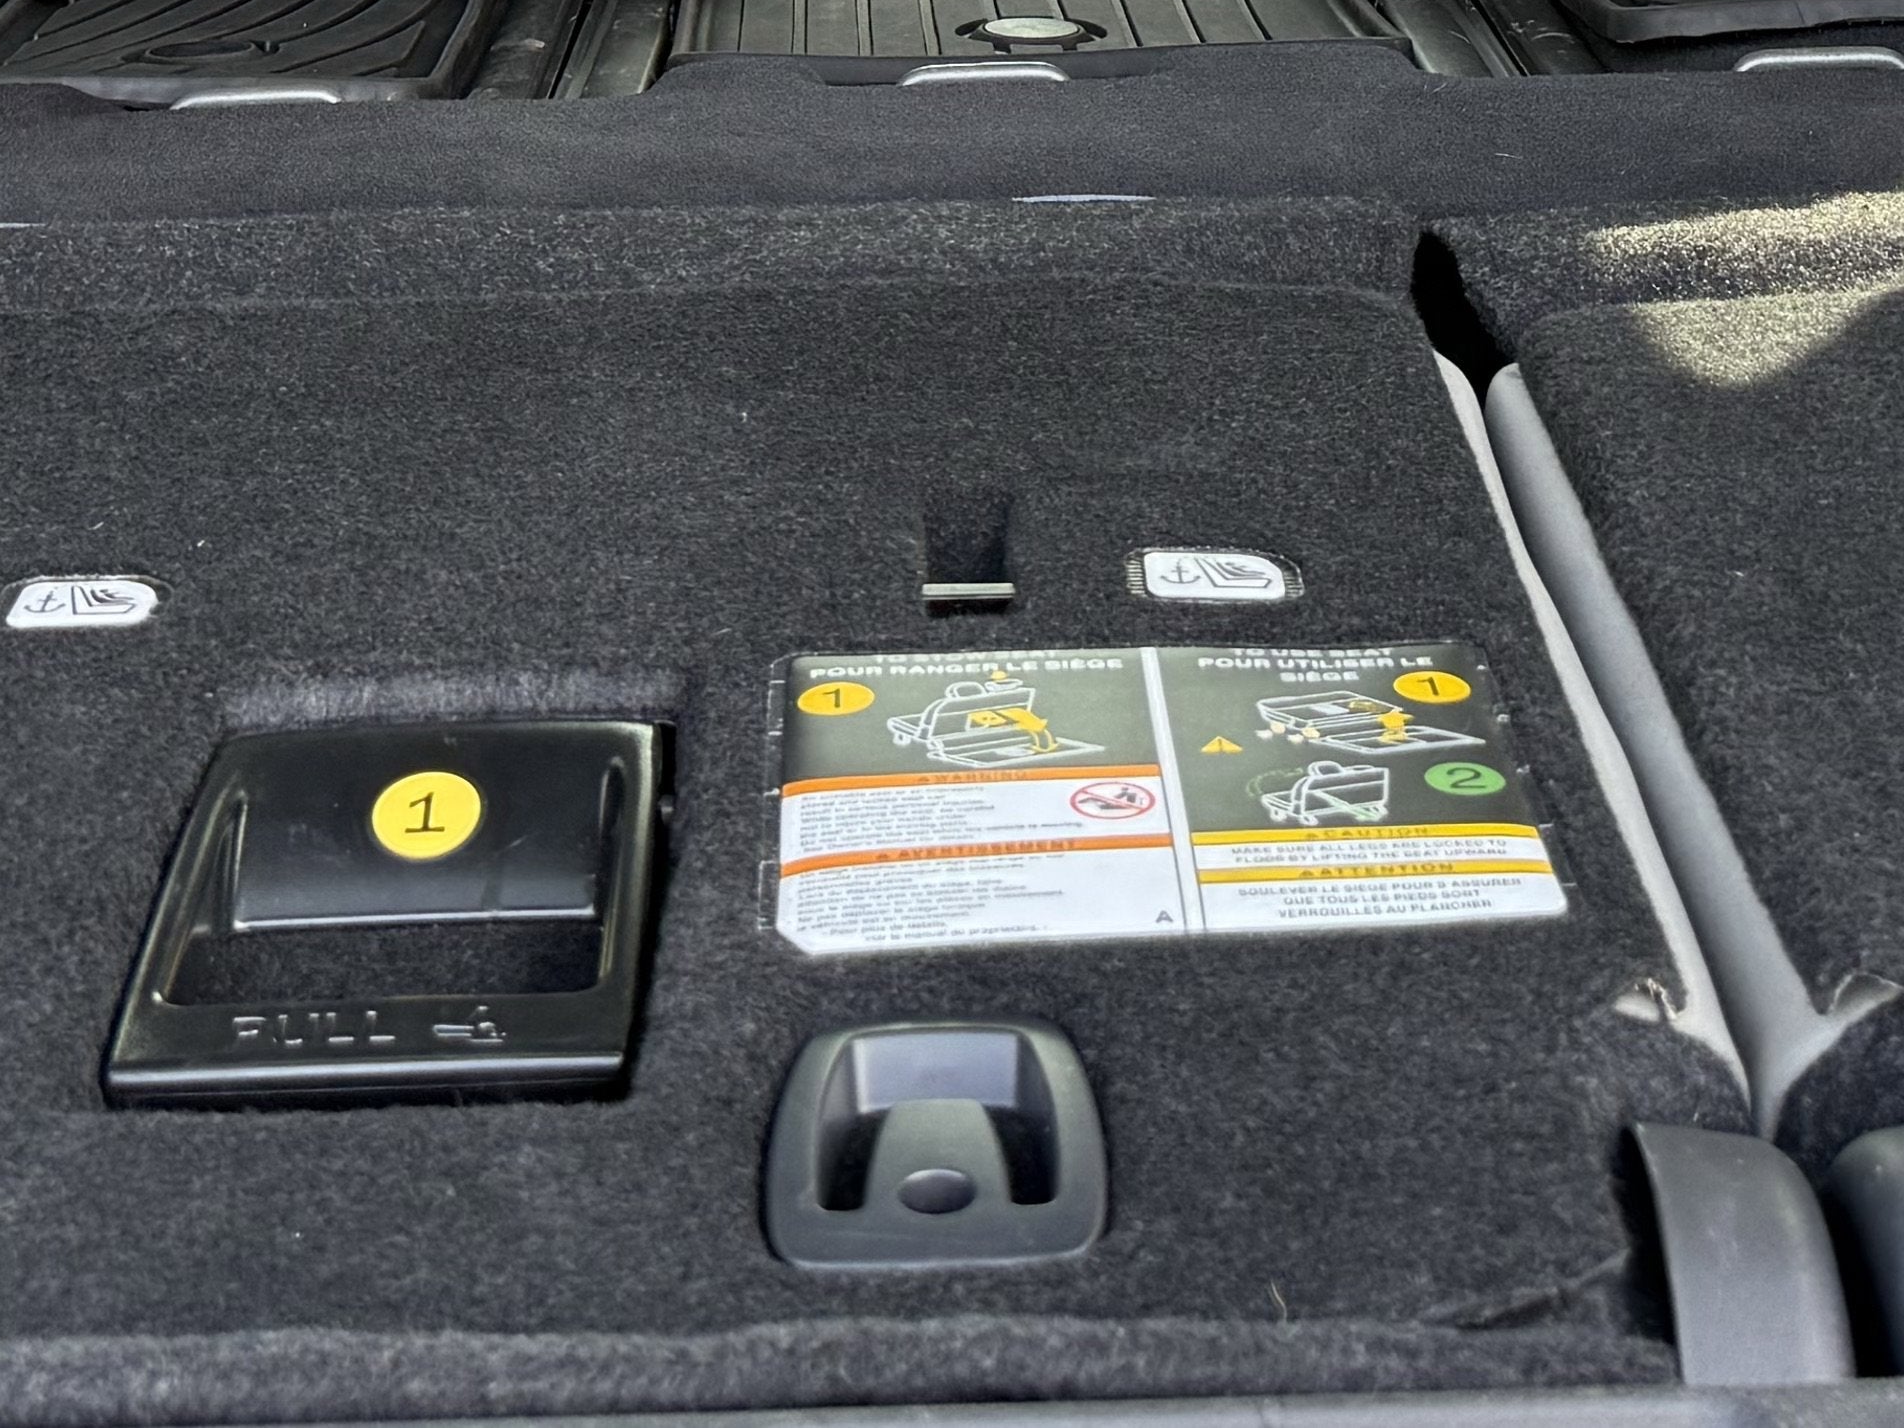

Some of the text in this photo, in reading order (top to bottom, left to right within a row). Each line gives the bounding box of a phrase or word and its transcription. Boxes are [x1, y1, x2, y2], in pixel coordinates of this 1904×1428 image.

[809, 666, 882, 679] POUR
[890, 663, 998, 675] RANGER
[1006, 661, 1038, 671] LE
[1197, 656, 1434, 669] POUR UTILISER LE
[1415, 676, 1440, 696] 1
[822, 687, 841, 708] 1
[1446, 767, 1488, 789] 2
[404, 791, 446, 834] 1
[1323, 827, 1429, 839] CAUTION
[1320, 863, 1454, 877] ATTENTION
[1155, 909, 1174, 924] A
